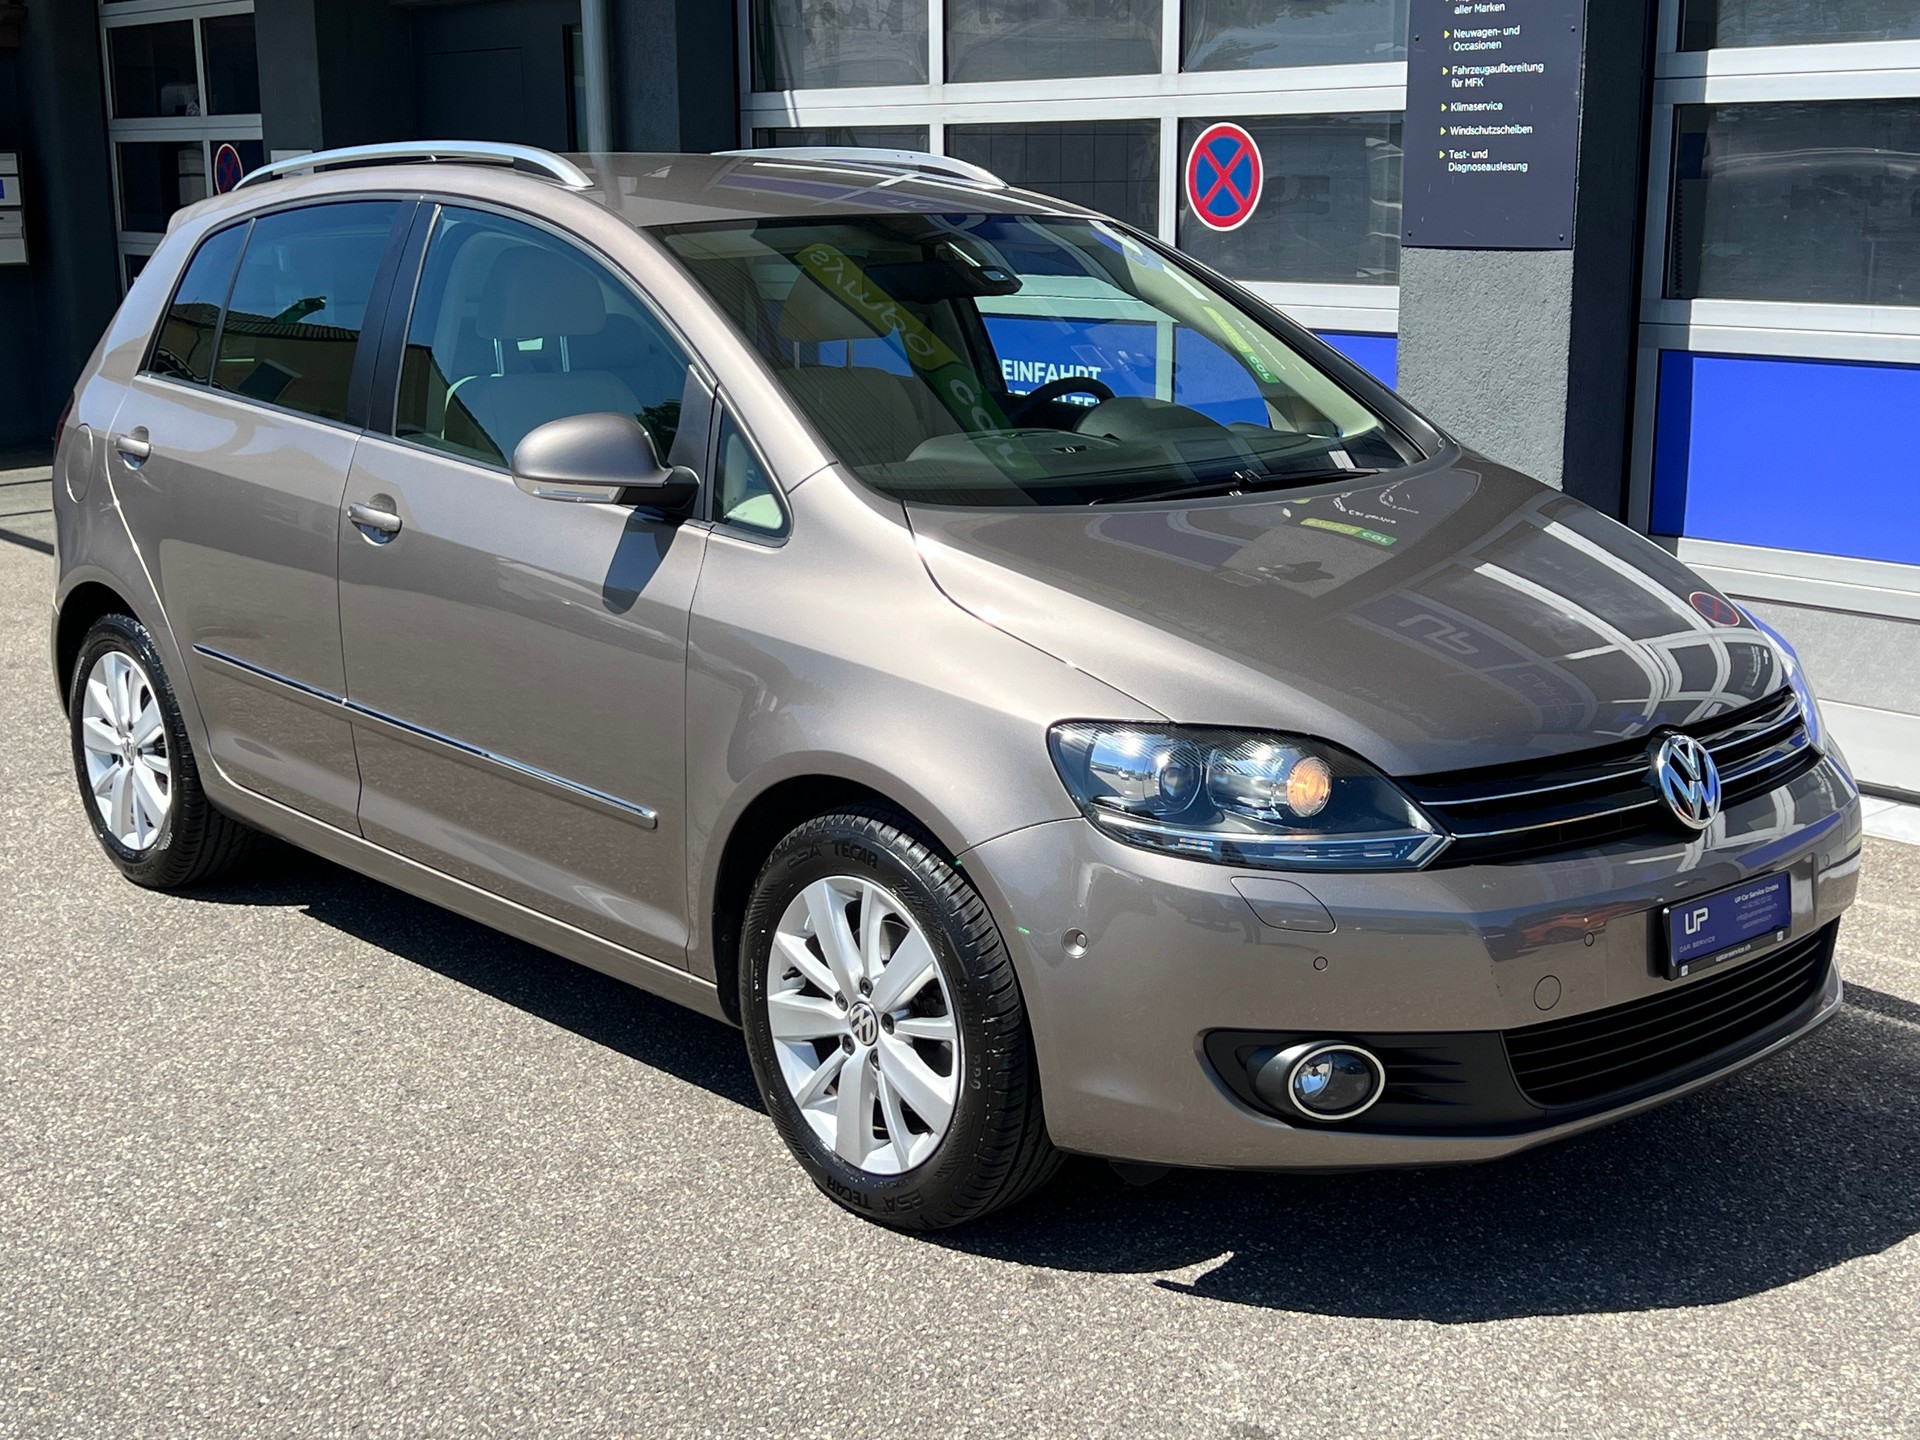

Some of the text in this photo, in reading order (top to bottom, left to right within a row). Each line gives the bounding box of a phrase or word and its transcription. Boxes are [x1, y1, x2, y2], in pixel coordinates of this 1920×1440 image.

[1454, 3, 1506, 15] aller Marken
[1453, 25, 1521, 39] Neuwagen- und
[1453, 41, 1502, 52] Occasionen
[1451, 62, 1545, 76] Fahrzeugaufbereitung
[1451, 77, 1485, 88] für MFK
[1450, 101, 1504, 112] Klimaservice
[1449, 124, 1534, 136] Windschutzscheiben
[1448, 148, 1489, 160] Test- und
[1448, 161, 1529, 174] Diagnoseauslesung
[831, 838, 879, 871] TECAR
[1684, 907, 1710, 936] UP
[1679, 935, 1717, 953] CAR SERVICE
